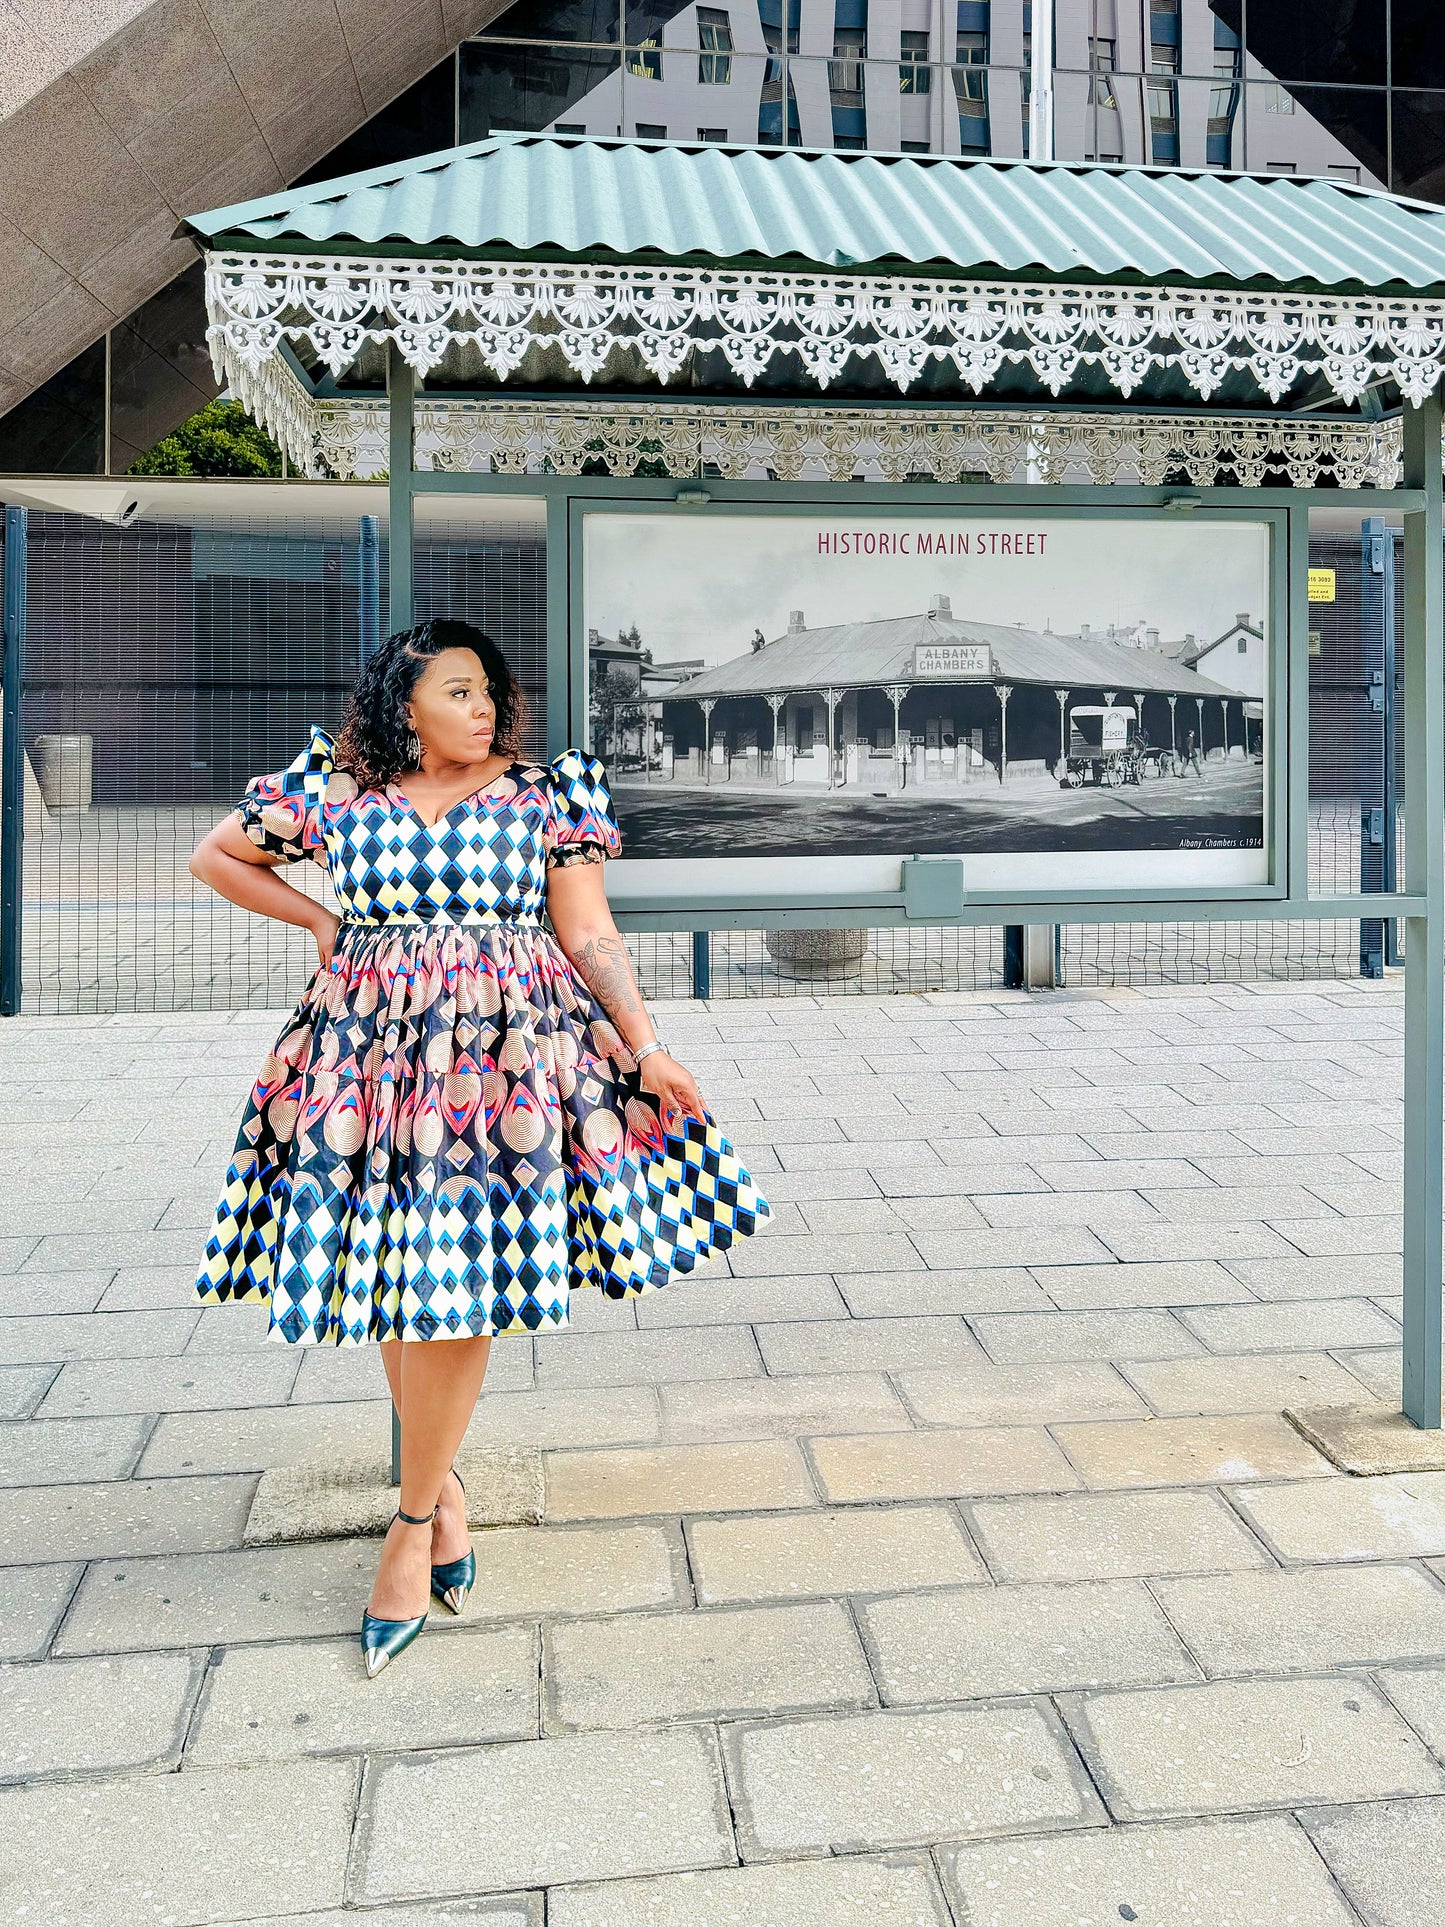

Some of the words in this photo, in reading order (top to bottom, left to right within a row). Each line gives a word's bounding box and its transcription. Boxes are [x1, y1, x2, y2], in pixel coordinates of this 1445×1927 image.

[818, 533, 910, 554] HISTORIC
[917, 533, 969, 554] MAIN
[976, 533, 1048, 554] STREET
[925, 648, 978, 659] ALBANY
[919, 659, 984, 670] CHAMBERS
[1179, 838, 1202, 849] Albany
[1204, 838, 1237, 847] Chambers
